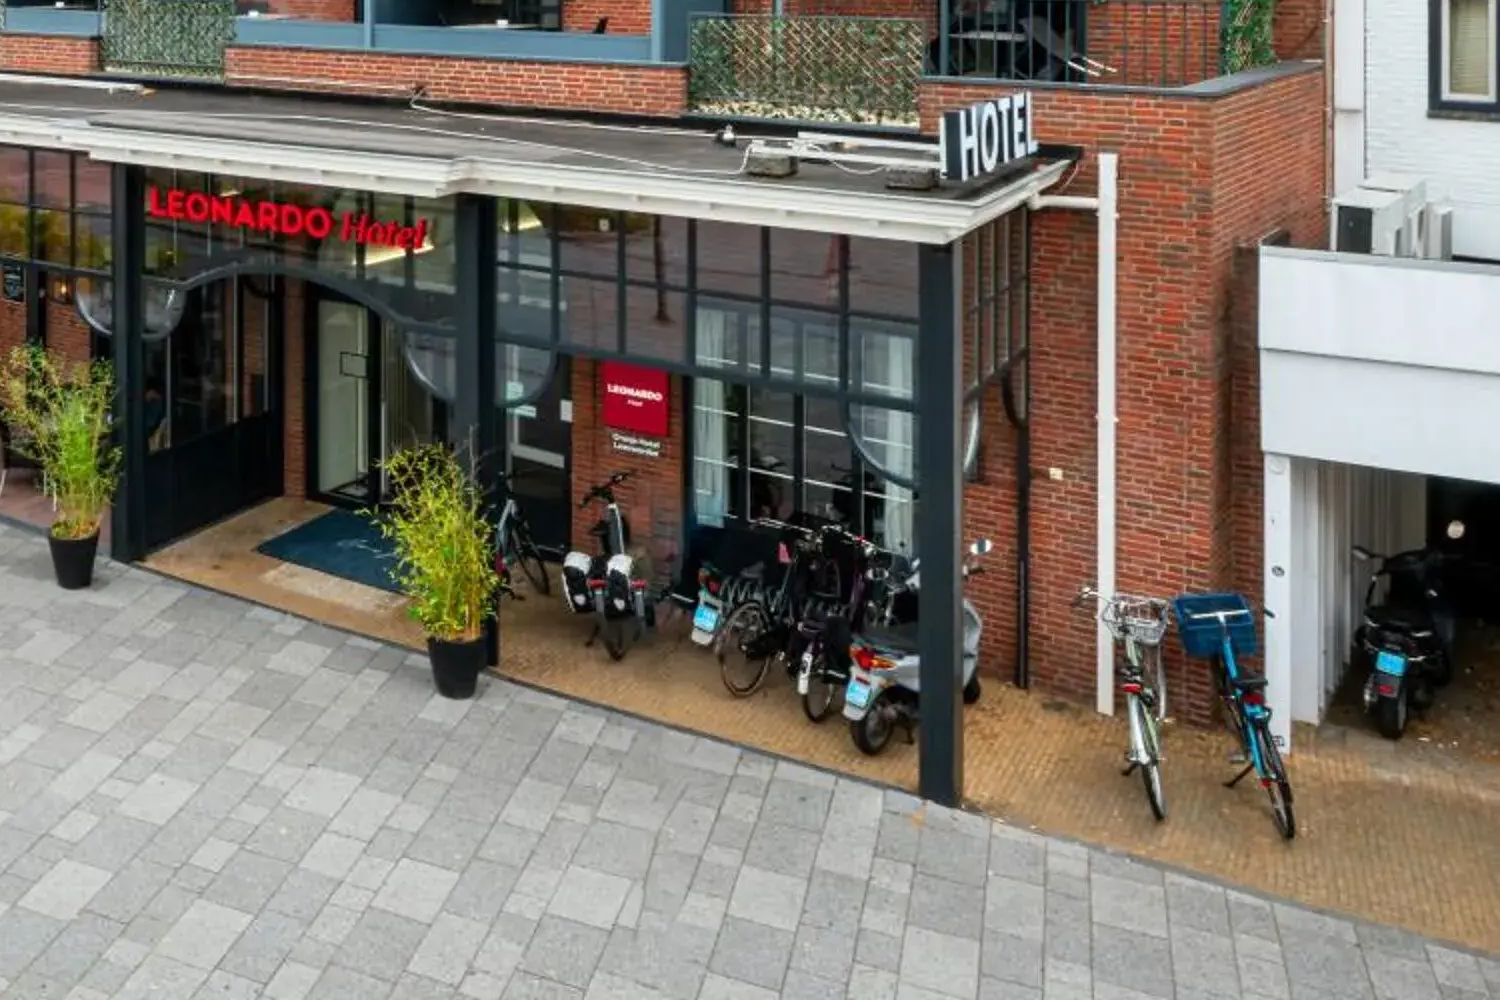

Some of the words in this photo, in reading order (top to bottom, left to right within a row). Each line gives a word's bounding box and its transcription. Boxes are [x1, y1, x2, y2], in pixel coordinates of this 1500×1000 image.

[960, 91, 1038, 183] HOTEL
[149, 186, 334, 239] LEONARDO
[339, 210, 429, 250] Hotel
[607, 383, 663, 401] LEONARDO
